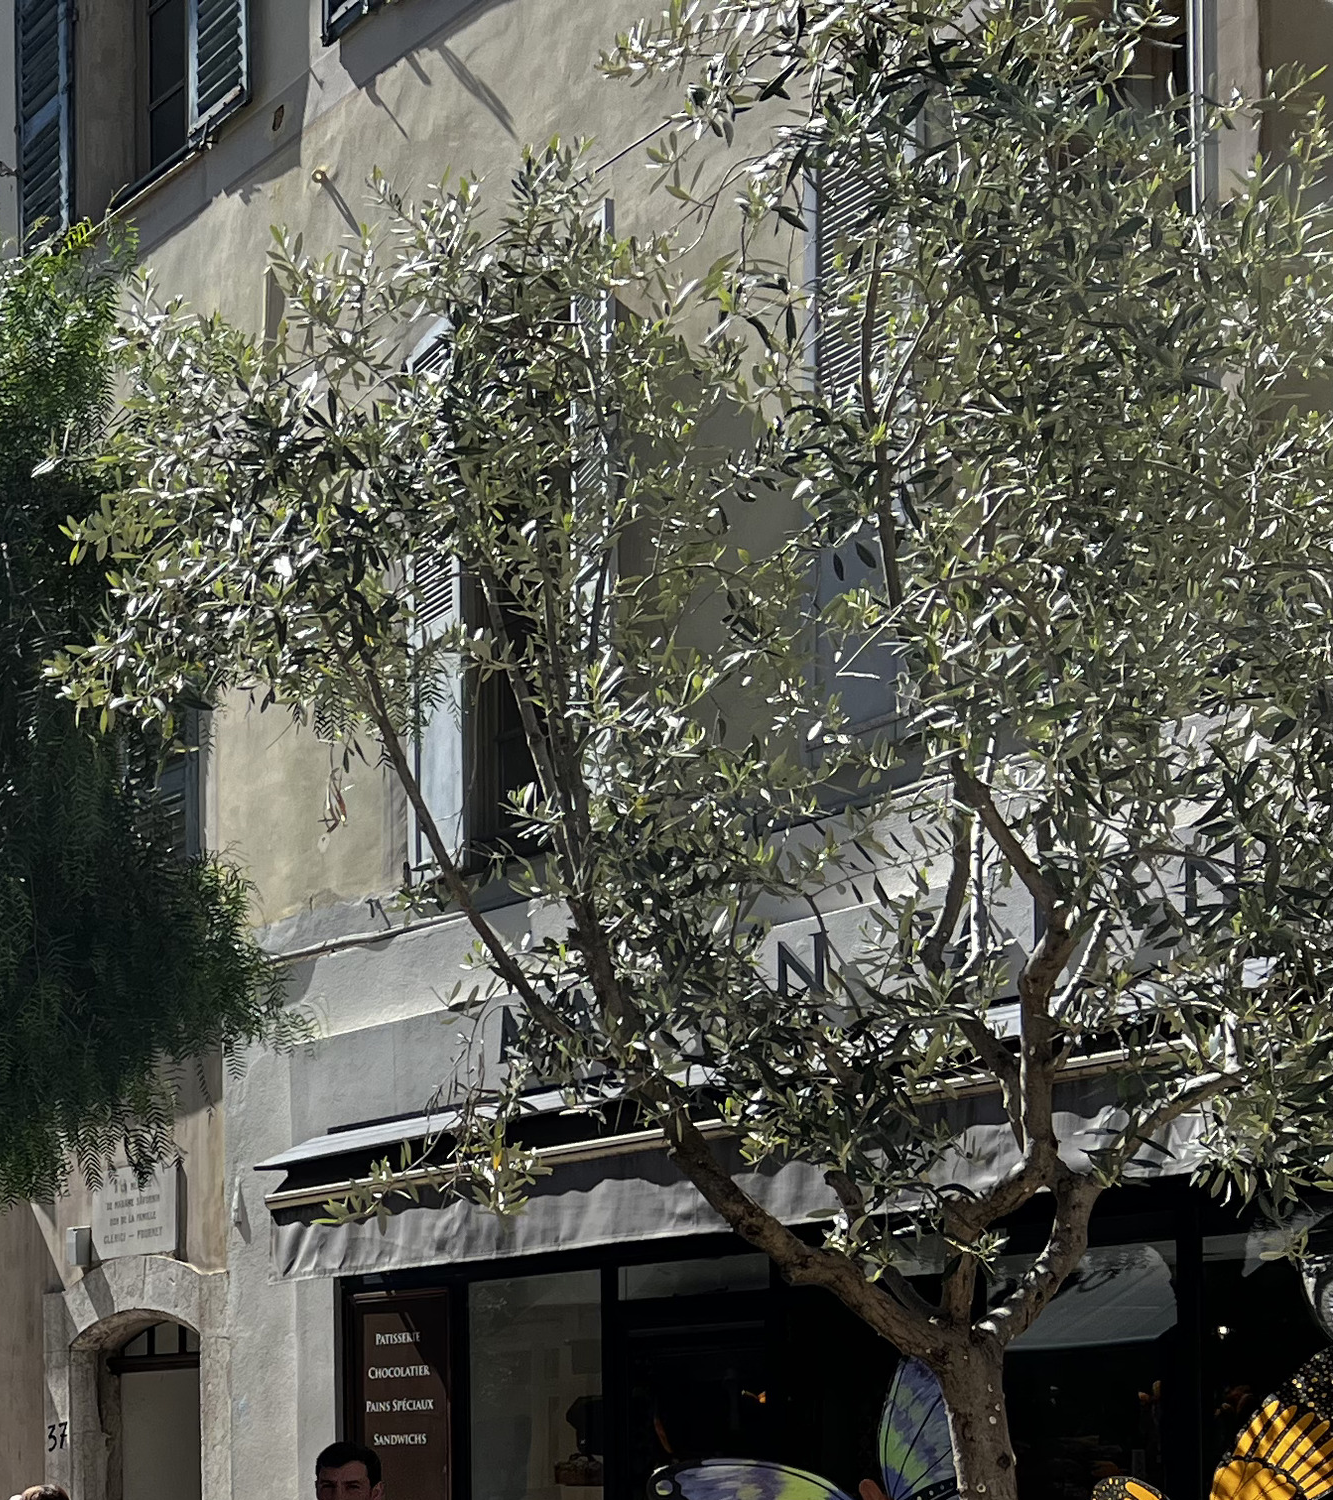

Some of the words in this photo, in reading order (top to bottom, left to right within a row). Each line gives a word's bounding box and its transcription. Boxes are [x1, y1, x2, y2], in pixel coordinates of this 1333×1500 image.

[375, 1331, 421, 1346] PATISSERIE
[368, 1364, 431, 1379] CHOCOLATIER
[366, 1400, 391, 1413] PAINS
[392, 1397, 435, 1412] SPÉCIAUX
[47, 1421, 68, 1452] 37
[373, 1433, 427, 1446] SANDWICHS
